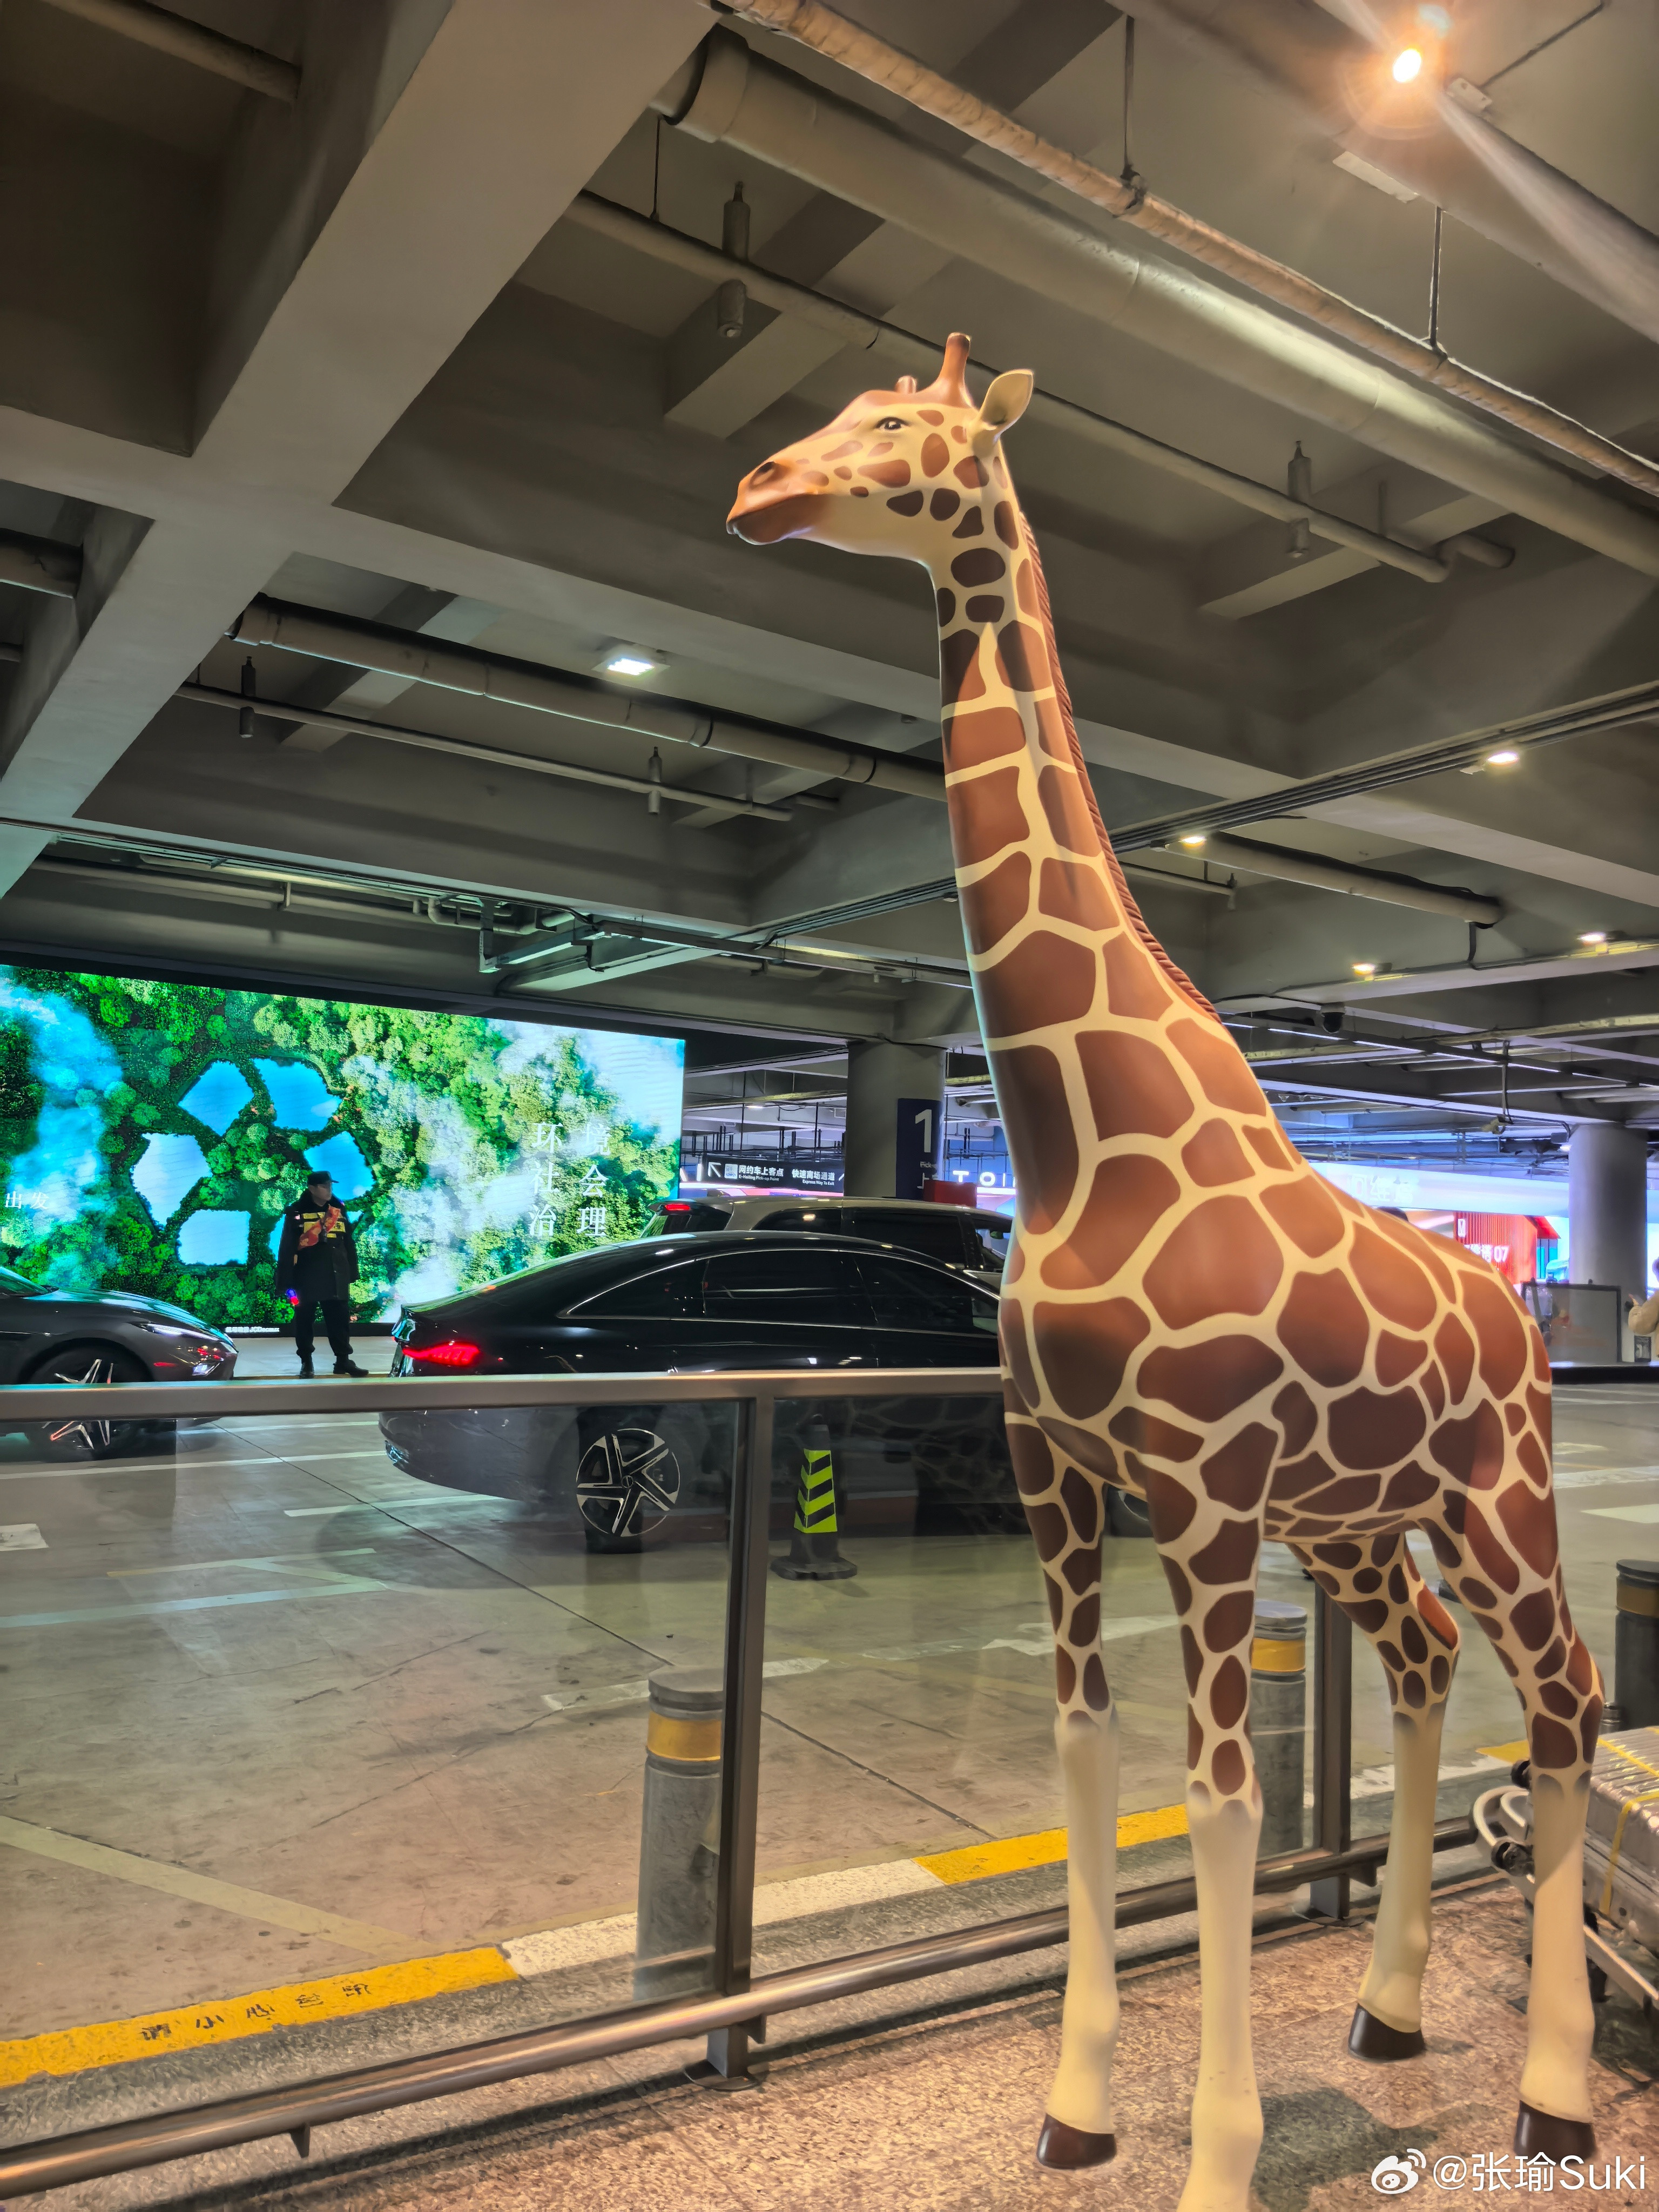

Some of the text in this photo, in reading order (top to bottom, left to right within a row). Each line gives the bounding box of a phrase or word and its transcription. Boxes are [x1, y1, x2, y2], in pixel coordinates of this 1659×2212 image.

[531, 1121, 612, 1156] 环境
[915, 1109, 932, 1153] 1
[529, 1159, 610, 1198] 社会
[739, 1165, 784, 1177] 网约车上客点
[792, 1169, 835, 1181] 快速离场通道
[5, 1190, 50, 1210] 出发
[528, 1203, 608, 1237] 治理
[1494, 1245, 1509, 1263] 07
